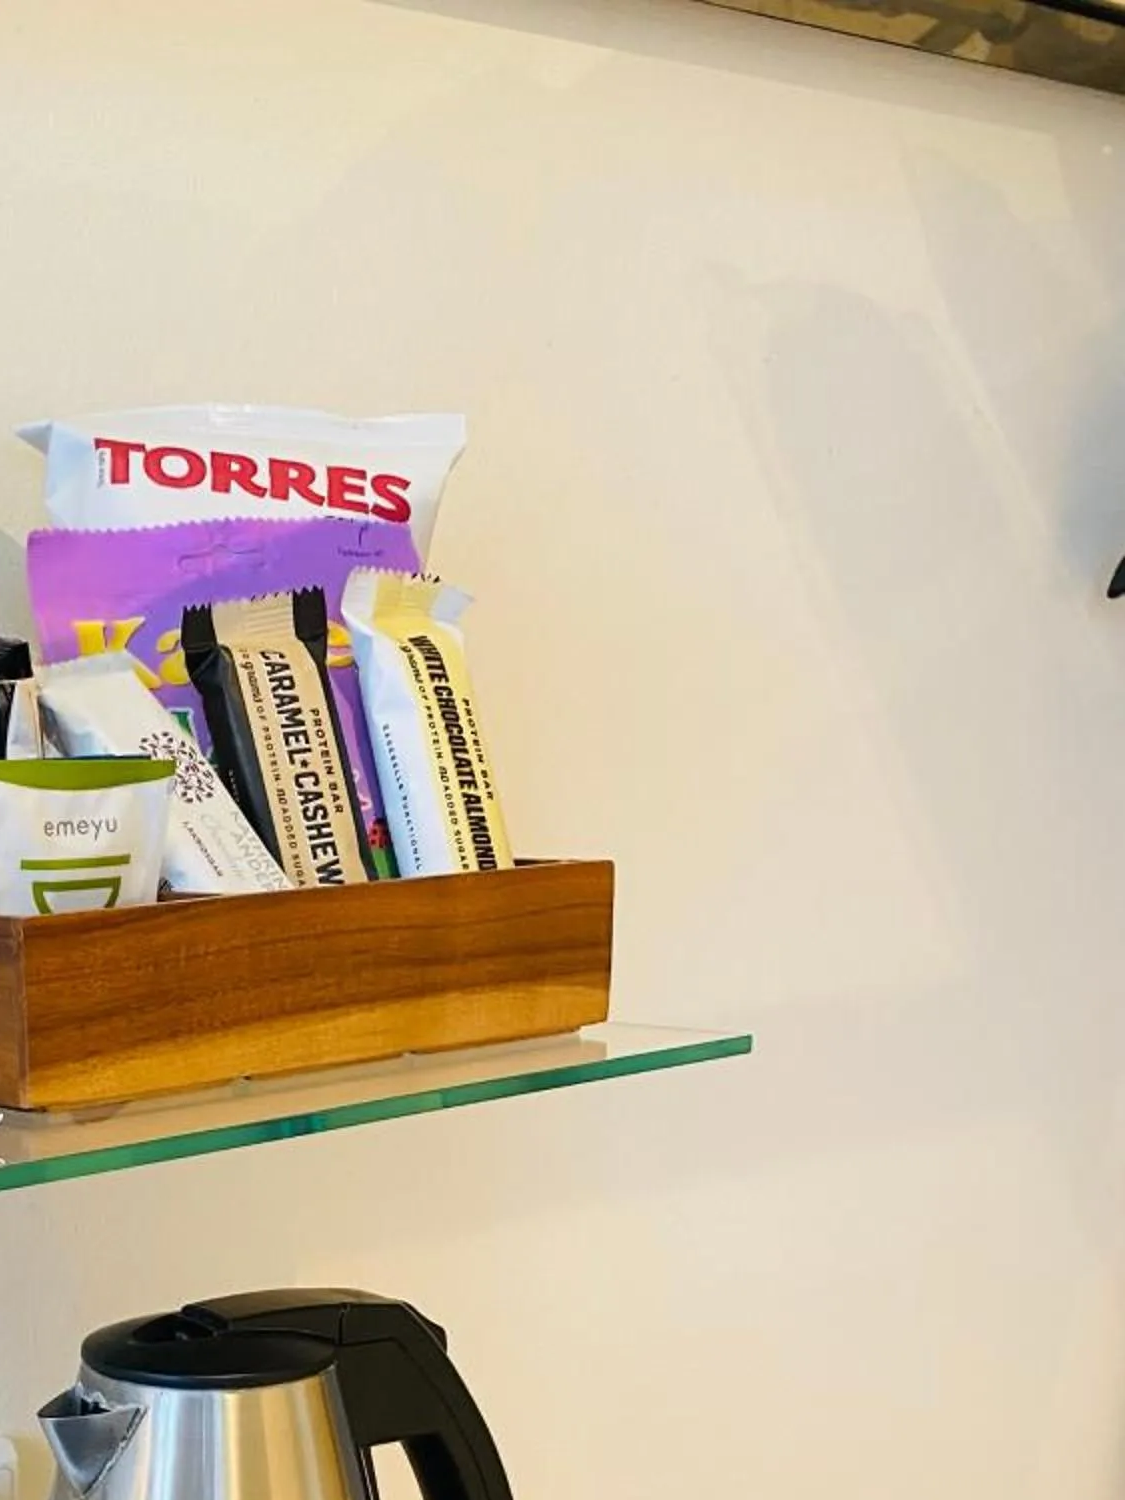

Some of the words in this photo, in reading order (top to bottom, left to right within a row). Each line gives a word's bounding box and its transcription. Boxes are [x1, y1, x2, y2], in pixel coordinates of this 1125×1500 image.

[94, 437, 411, 523] TORRES
[256, 705, 268, 720] OF
[262, 726, 281, 783] PROTEIN
[281, 807, 298, 848] ADDED
[291, 853, 306, 888] SUGA
[259, 649, 311, 766] CARAMEL
[294, 771, 346, 885] CASHEW
[311, 707, 335, 776] PROTEIN
[329, 781, 344, 814] BAR
[408, 635, 450, 685] WHITE
[433, 684, 480, 792] CHOCOLATE
[461, 790, 498, 871] ALMOND
[426, 704, 444, 760] PROTEIN
[441, 782, 458, 825] ADDED
[454, 830, 469, 871] SUGAR
[462, 697, 486, 763] PROTEIN
[481, 768, 494, 800] BAR
[43, 816, 118, 840] emeyu
